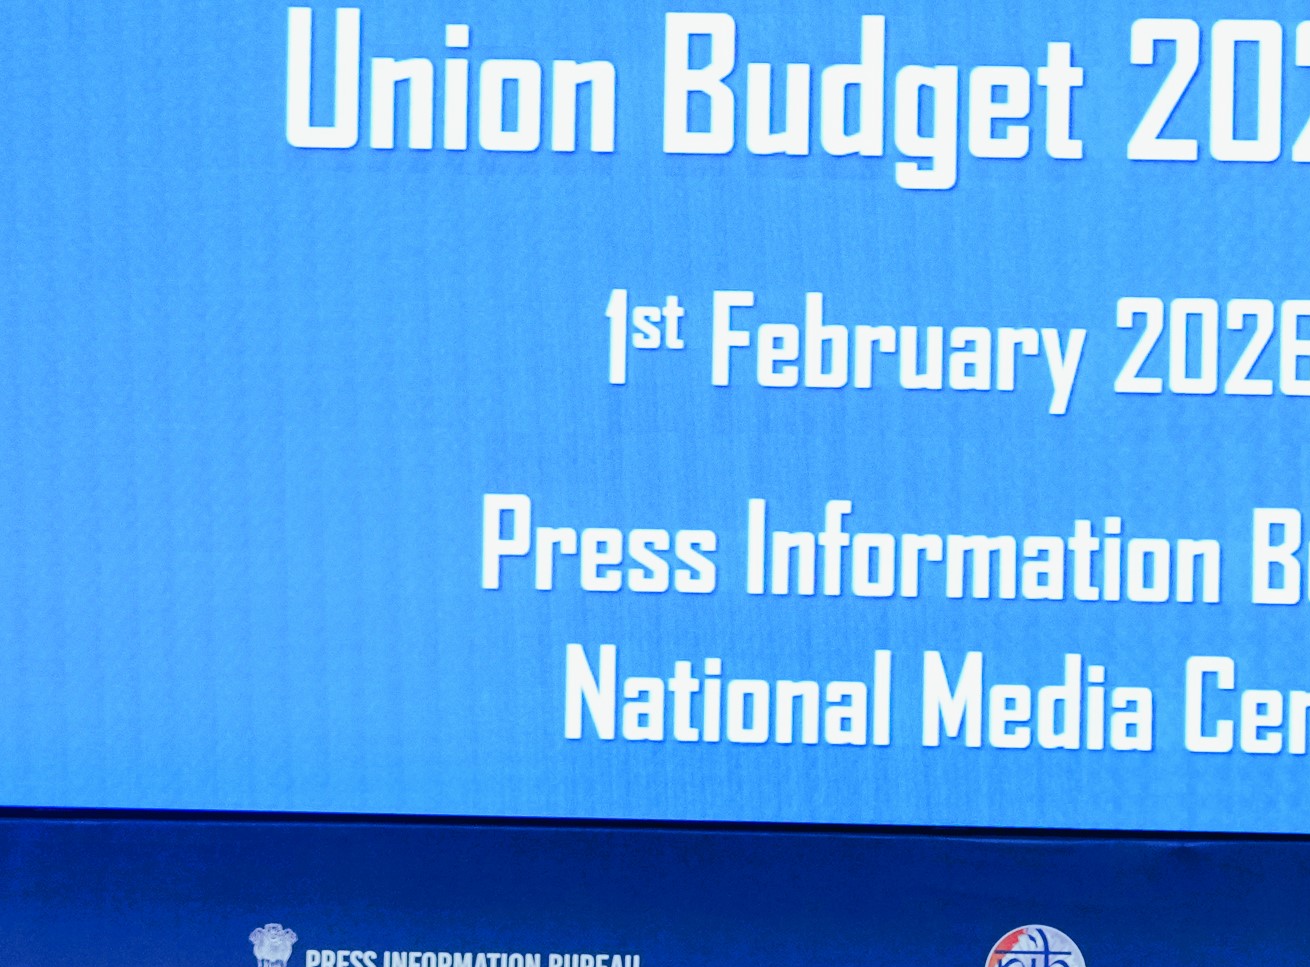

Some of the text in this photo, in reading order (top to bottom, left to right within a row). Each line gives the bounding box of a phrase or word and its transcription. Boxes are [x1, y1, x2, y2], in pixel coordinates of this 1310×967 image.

[286, 6, 616, 152] Union
[663, 12, 1084, 190] Budget
[605, 288, 685, 386] 1st
[712, 290, 1087, 415] February
[482, 493, 717, 594] Press
[747, 498, 1220, 604] Information
[564, 643, 892, 747] National
[922, 650, 1154, 752] Media
